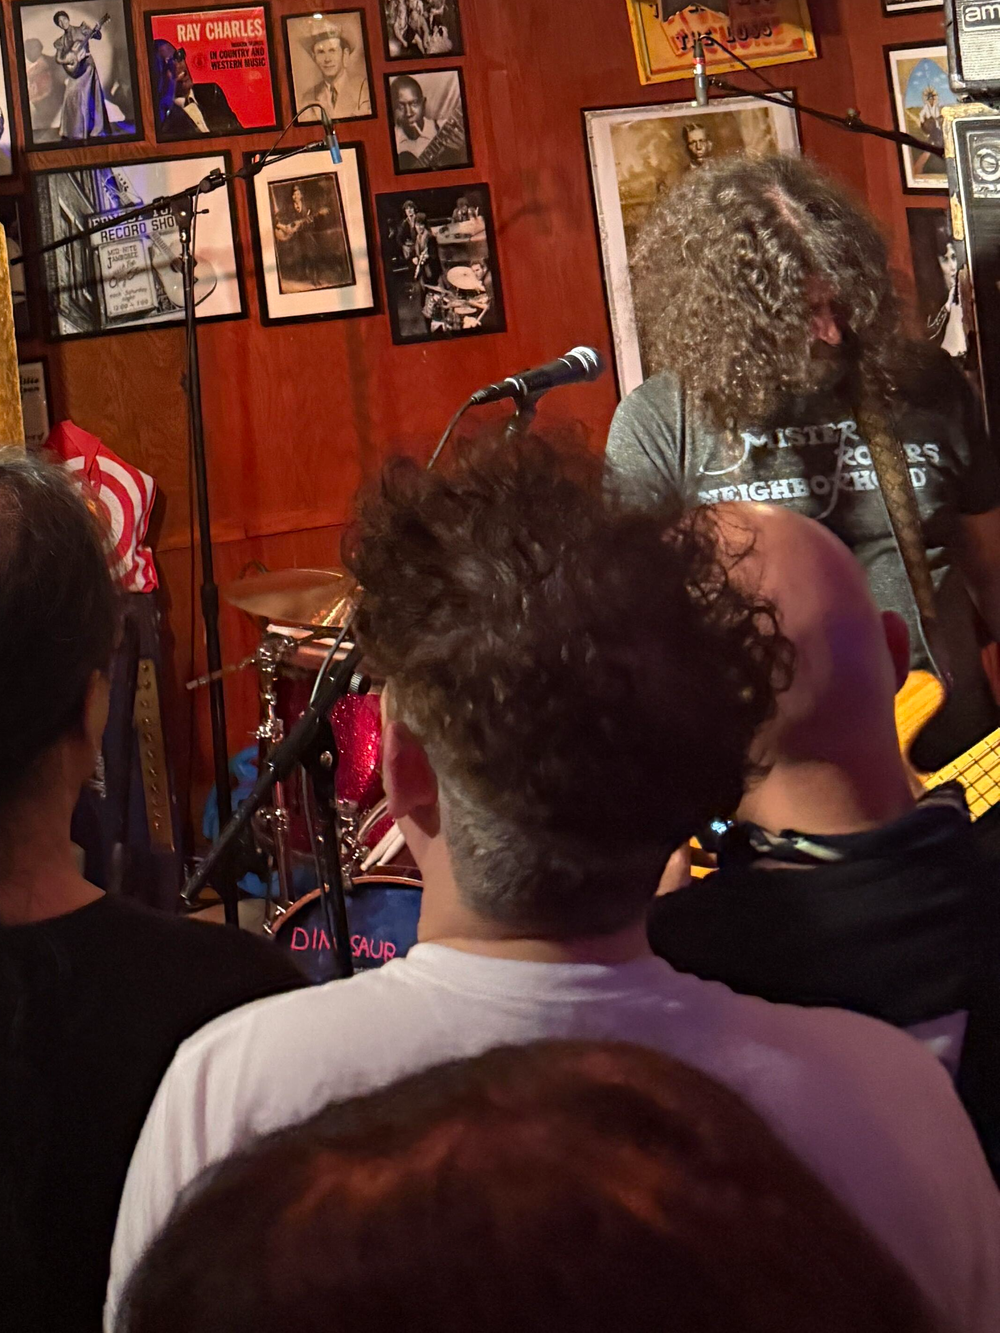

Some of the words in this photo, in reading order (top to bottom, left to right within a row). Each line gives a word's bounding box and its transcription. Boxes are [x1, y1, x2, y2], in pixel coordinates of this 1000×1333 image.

[965, 4, 1000, 22] am
[176, 23, 201, 43] RAY
[205, 18, 263, 41] CHARLES
[209, 51, 217, 60] IN
[219, 48, 249, 60] COUNTRY
[251, 47, 265, 57] AND
[211, 60, 243, 70] WESTERN
[244, 57, 266, 68] MUSIC
[100, 222, 146, 243] RECORD
[151, 215, 175, 232] SHO
[834, 443, 940, 465] RORS
[698, 467, 926, 506] NEIGHBORHD
[290, 926, 396, 962] DINSAUR
